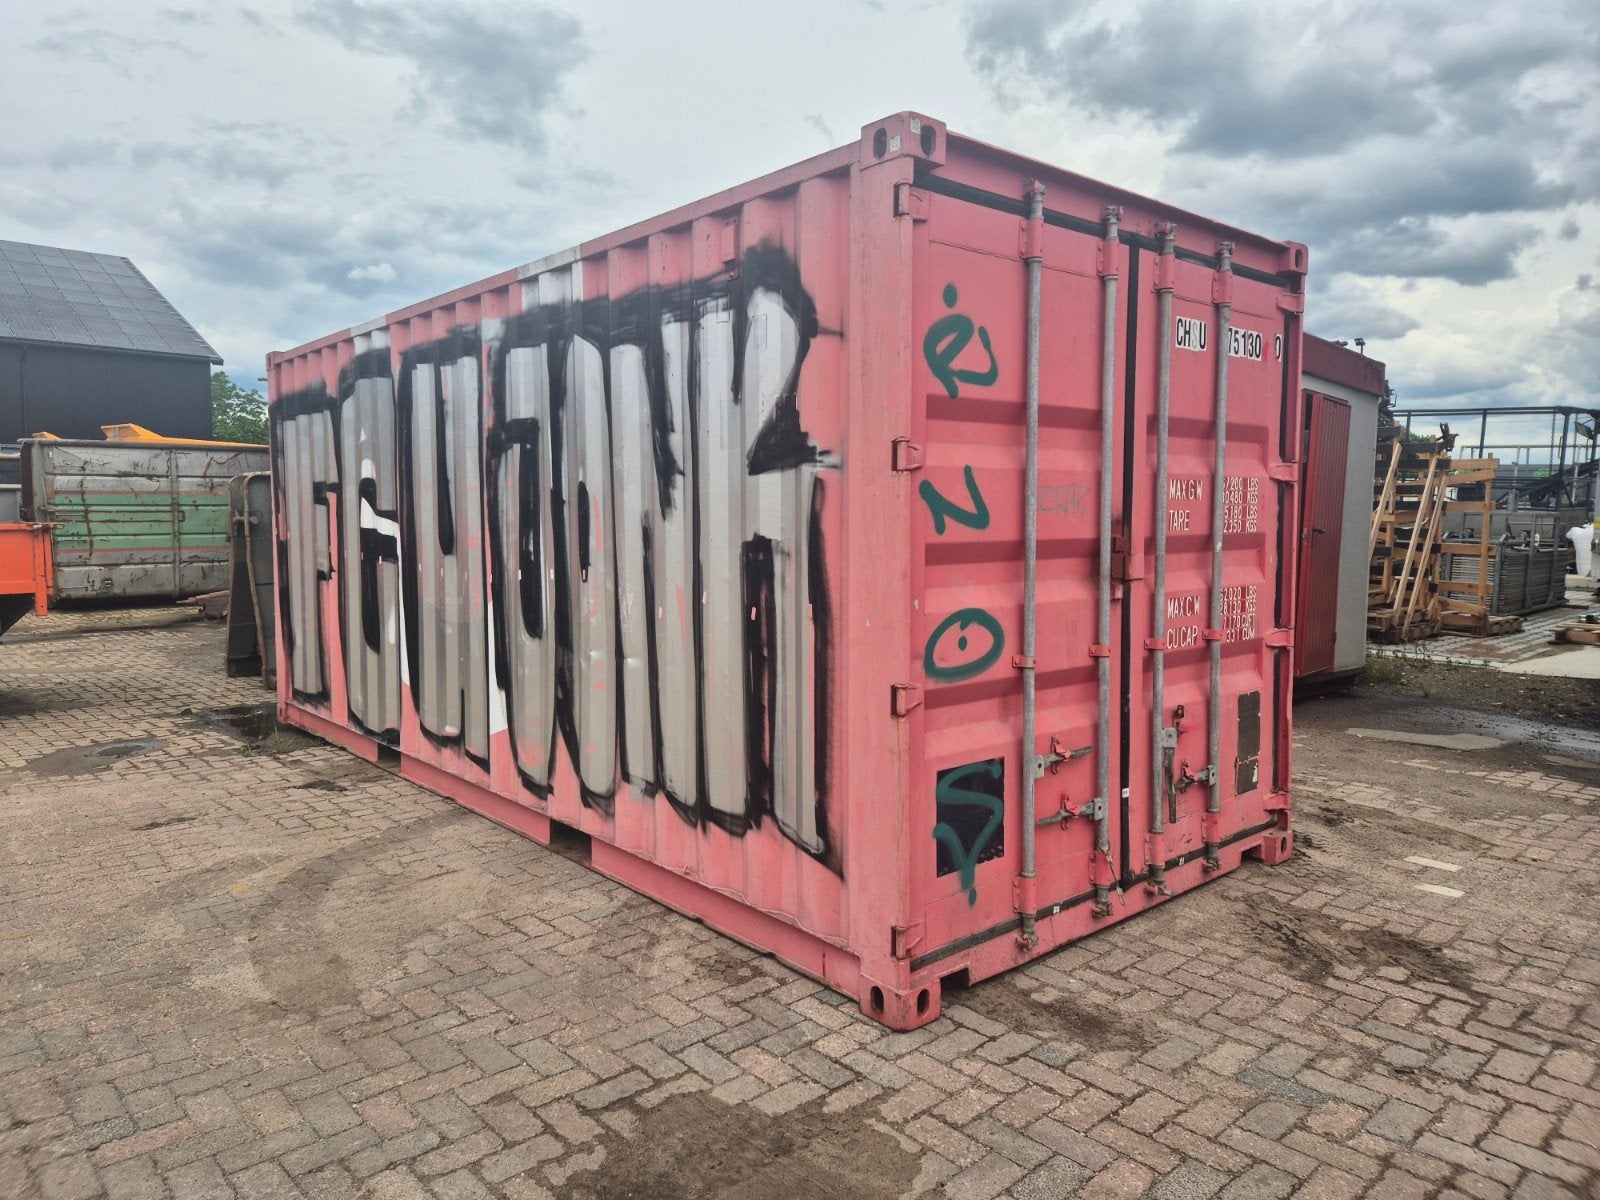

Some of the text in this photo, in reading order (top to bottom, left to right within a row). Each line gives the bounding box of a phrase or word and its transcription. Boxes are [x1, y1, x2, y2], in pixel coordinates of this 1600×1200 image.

[1169, 479, 1187, 500] MAX
[1247, 478, 1259, 491] LBS
[1247, 491, 1259, 504] KGS
[1246, 507, 1258, 519] LBS
[1169, 510, 1190, 531] TARE
[1223, 520, 1257, 533] 2350 KGS
[1245, 585, 1257, 599] LBS
[1167, 597, 1185, 619] MAX
[1245, 599, 1257, 613] KGS
